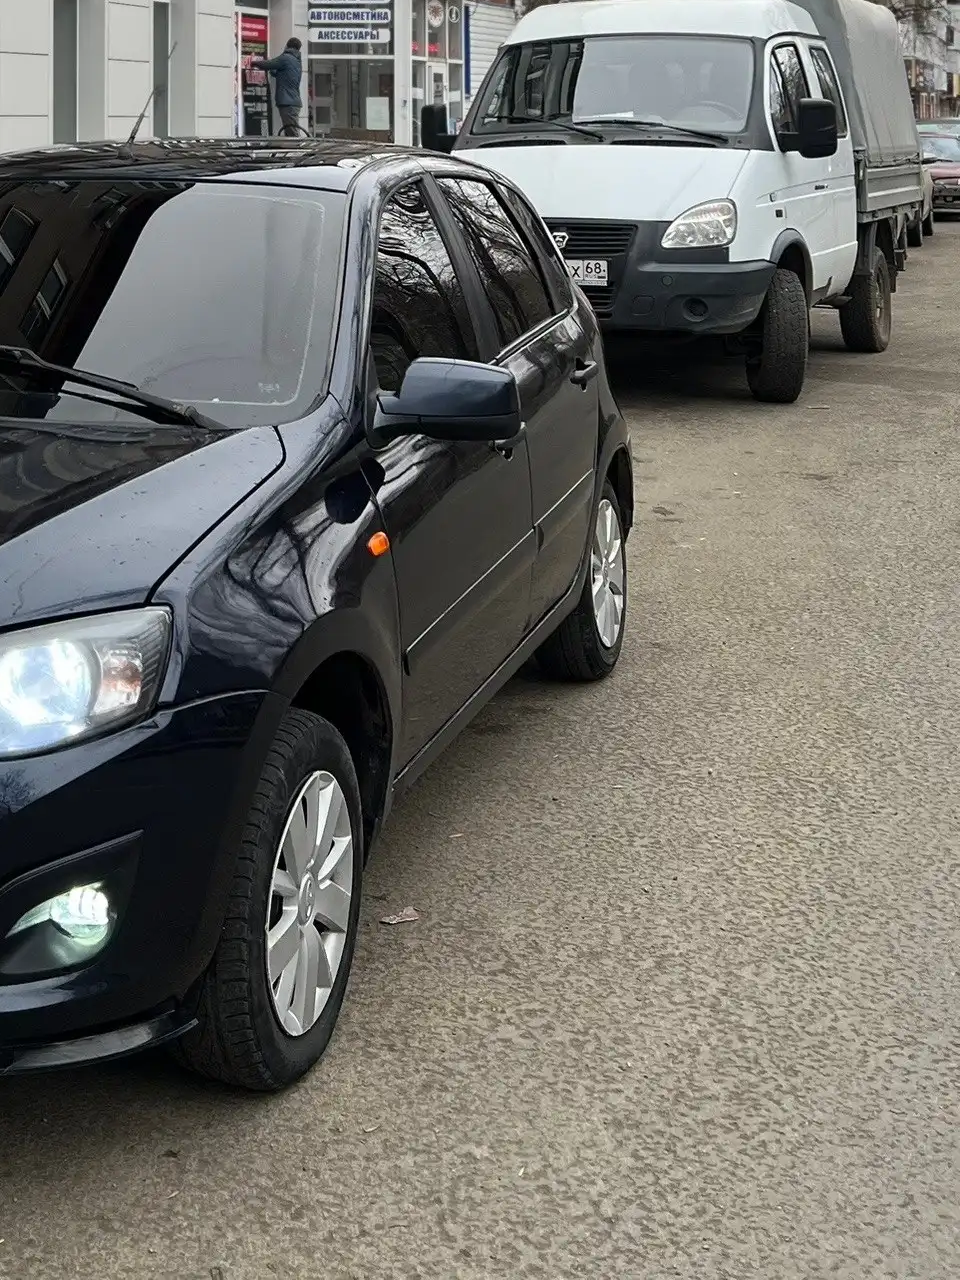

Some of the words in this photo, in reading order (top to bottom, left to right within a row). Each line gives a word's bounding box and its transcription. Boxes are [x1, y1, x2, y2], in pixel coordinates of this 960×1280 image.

[310, 11, 389, 21] АВТОКОСМЕТИКА
[317, 30, 380, 40] АКСЕССУАРЫ
[585, 261, 602, 275] 68
